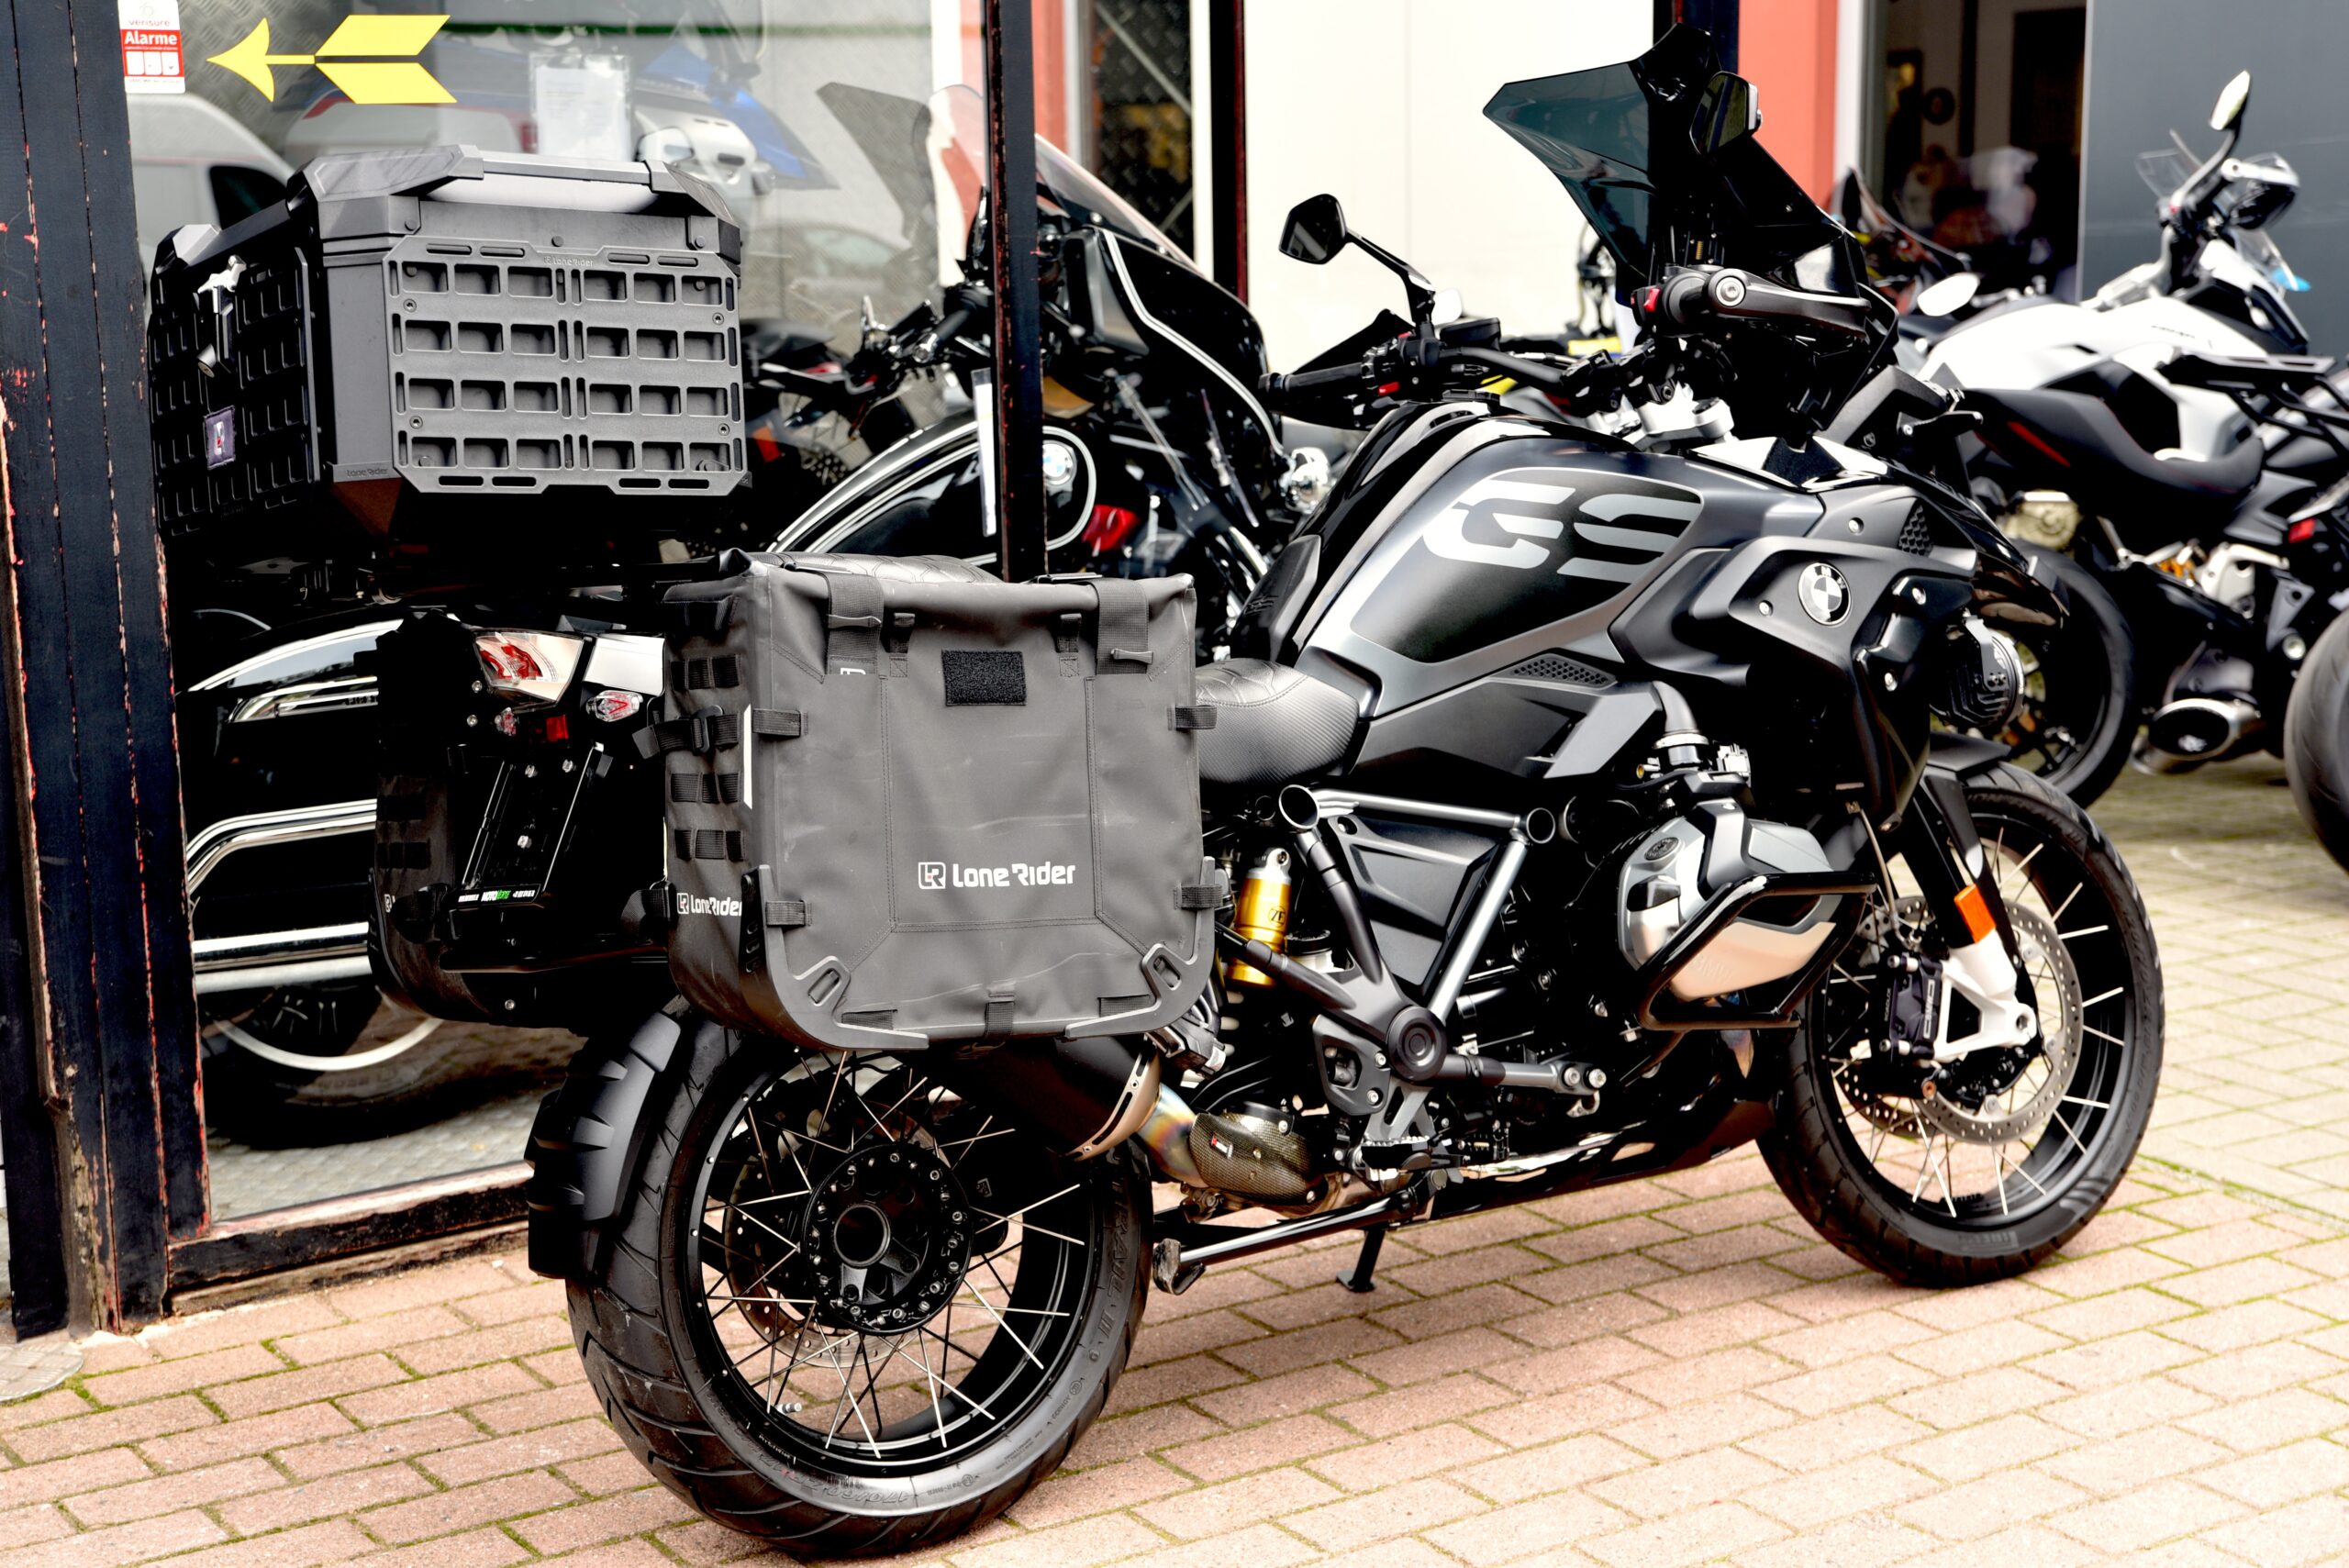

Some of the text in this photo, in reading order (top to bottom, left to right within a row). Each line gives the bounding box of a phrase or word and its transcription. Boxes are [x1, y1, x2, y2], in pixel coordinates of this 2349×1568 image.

[128, 19, 171, 28] verisure
[124, 30, 178, 45] Alarme
[1422, 479, 1701, 584] GS
[1271, 907, 1286, 926] ZF
